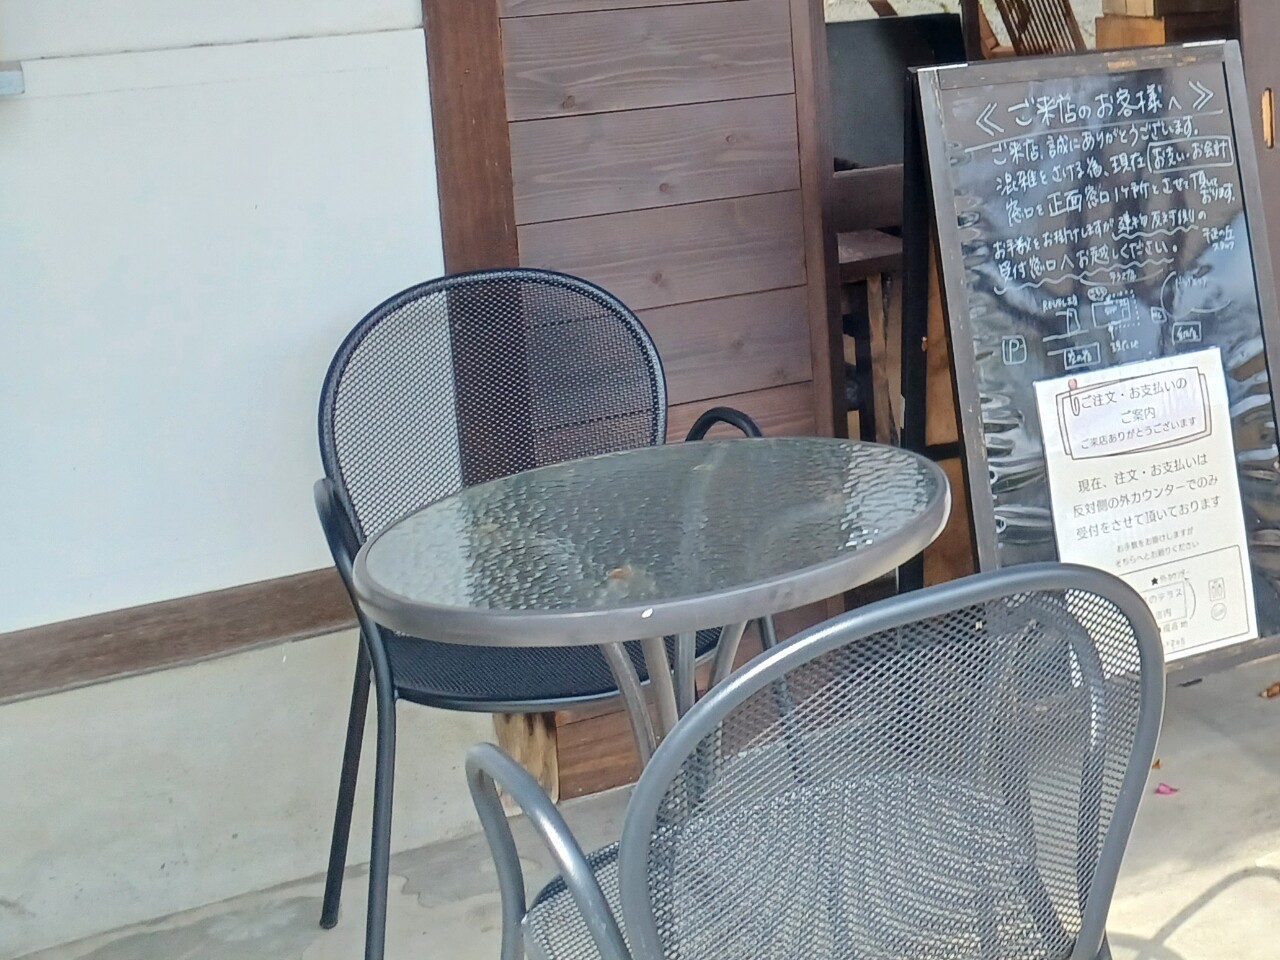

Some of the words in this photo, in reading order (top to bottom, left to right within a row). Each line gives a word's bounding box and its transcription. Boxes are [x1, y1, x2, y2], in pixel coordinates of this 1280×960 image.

[1081, 377, 1188, 409] ご注文・お支払いの
[1081, 416, 1197, 450] ご来店ありがとうございます
[1121, 406, 1156, 424] ご案内
[1077, 453, 1209, 493] 現在、注文・お支払いは
[1073, 474, 1219, 519] 反対側の外カウンターでのみ
[1076, 495, 1221, 541] 受付をさせて頂いております
